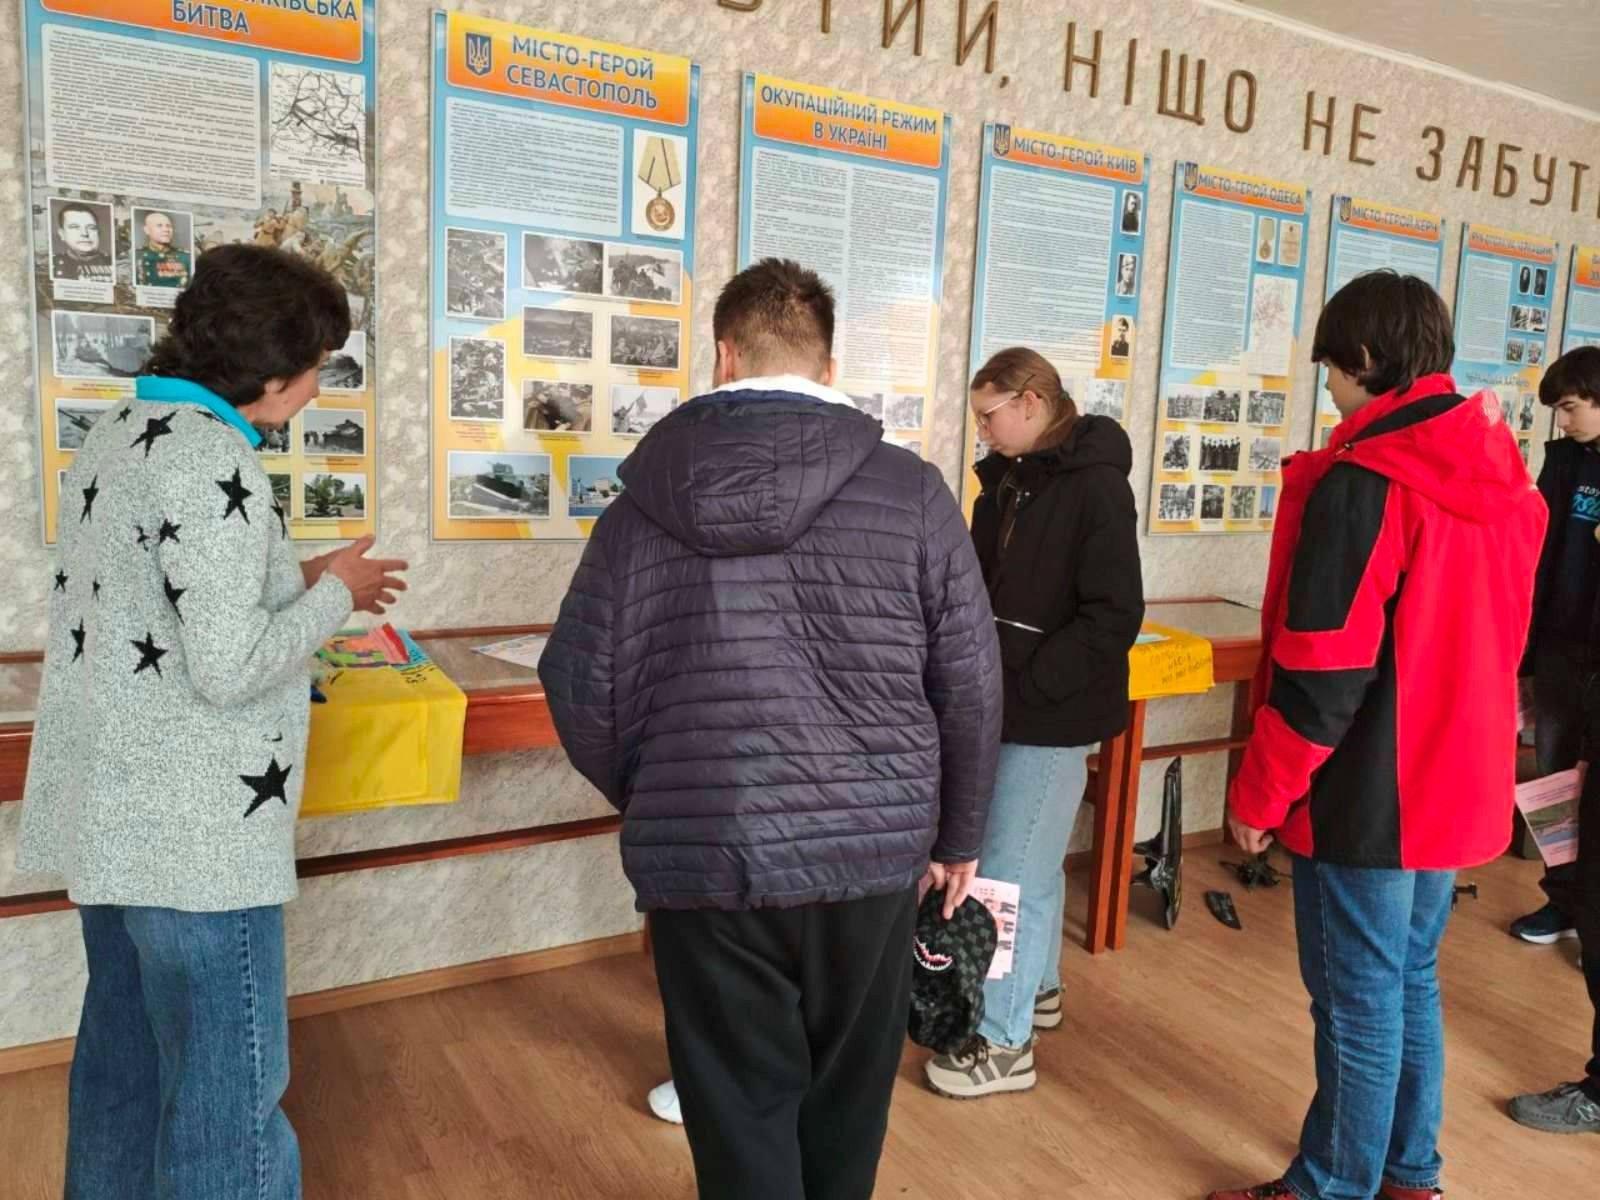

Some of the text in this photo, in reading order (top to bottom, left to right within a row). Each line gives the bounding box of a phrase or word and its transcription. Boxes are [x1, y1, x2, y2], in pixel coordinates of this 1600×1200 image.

[173, 1, 249, 33] БИТВА
[512, 35, 654, 80] МІСТО-ГЕРОЙ
[507, 64, 657, 109] СЕВАСТОПОЛЬ
[761, 85, 937, 135] ОКУПАЦІЙНИЙ РЕЖИМ
[814, 121, 887, 150] В УКРАЇНІ
[1014, 136, 1137, 174] МІСТО-ГЕРОЙ КИЇВ
[1303, 91, 1381, 166] НЕ
[1415, 125, 1600, 219] ЗАБУТ
